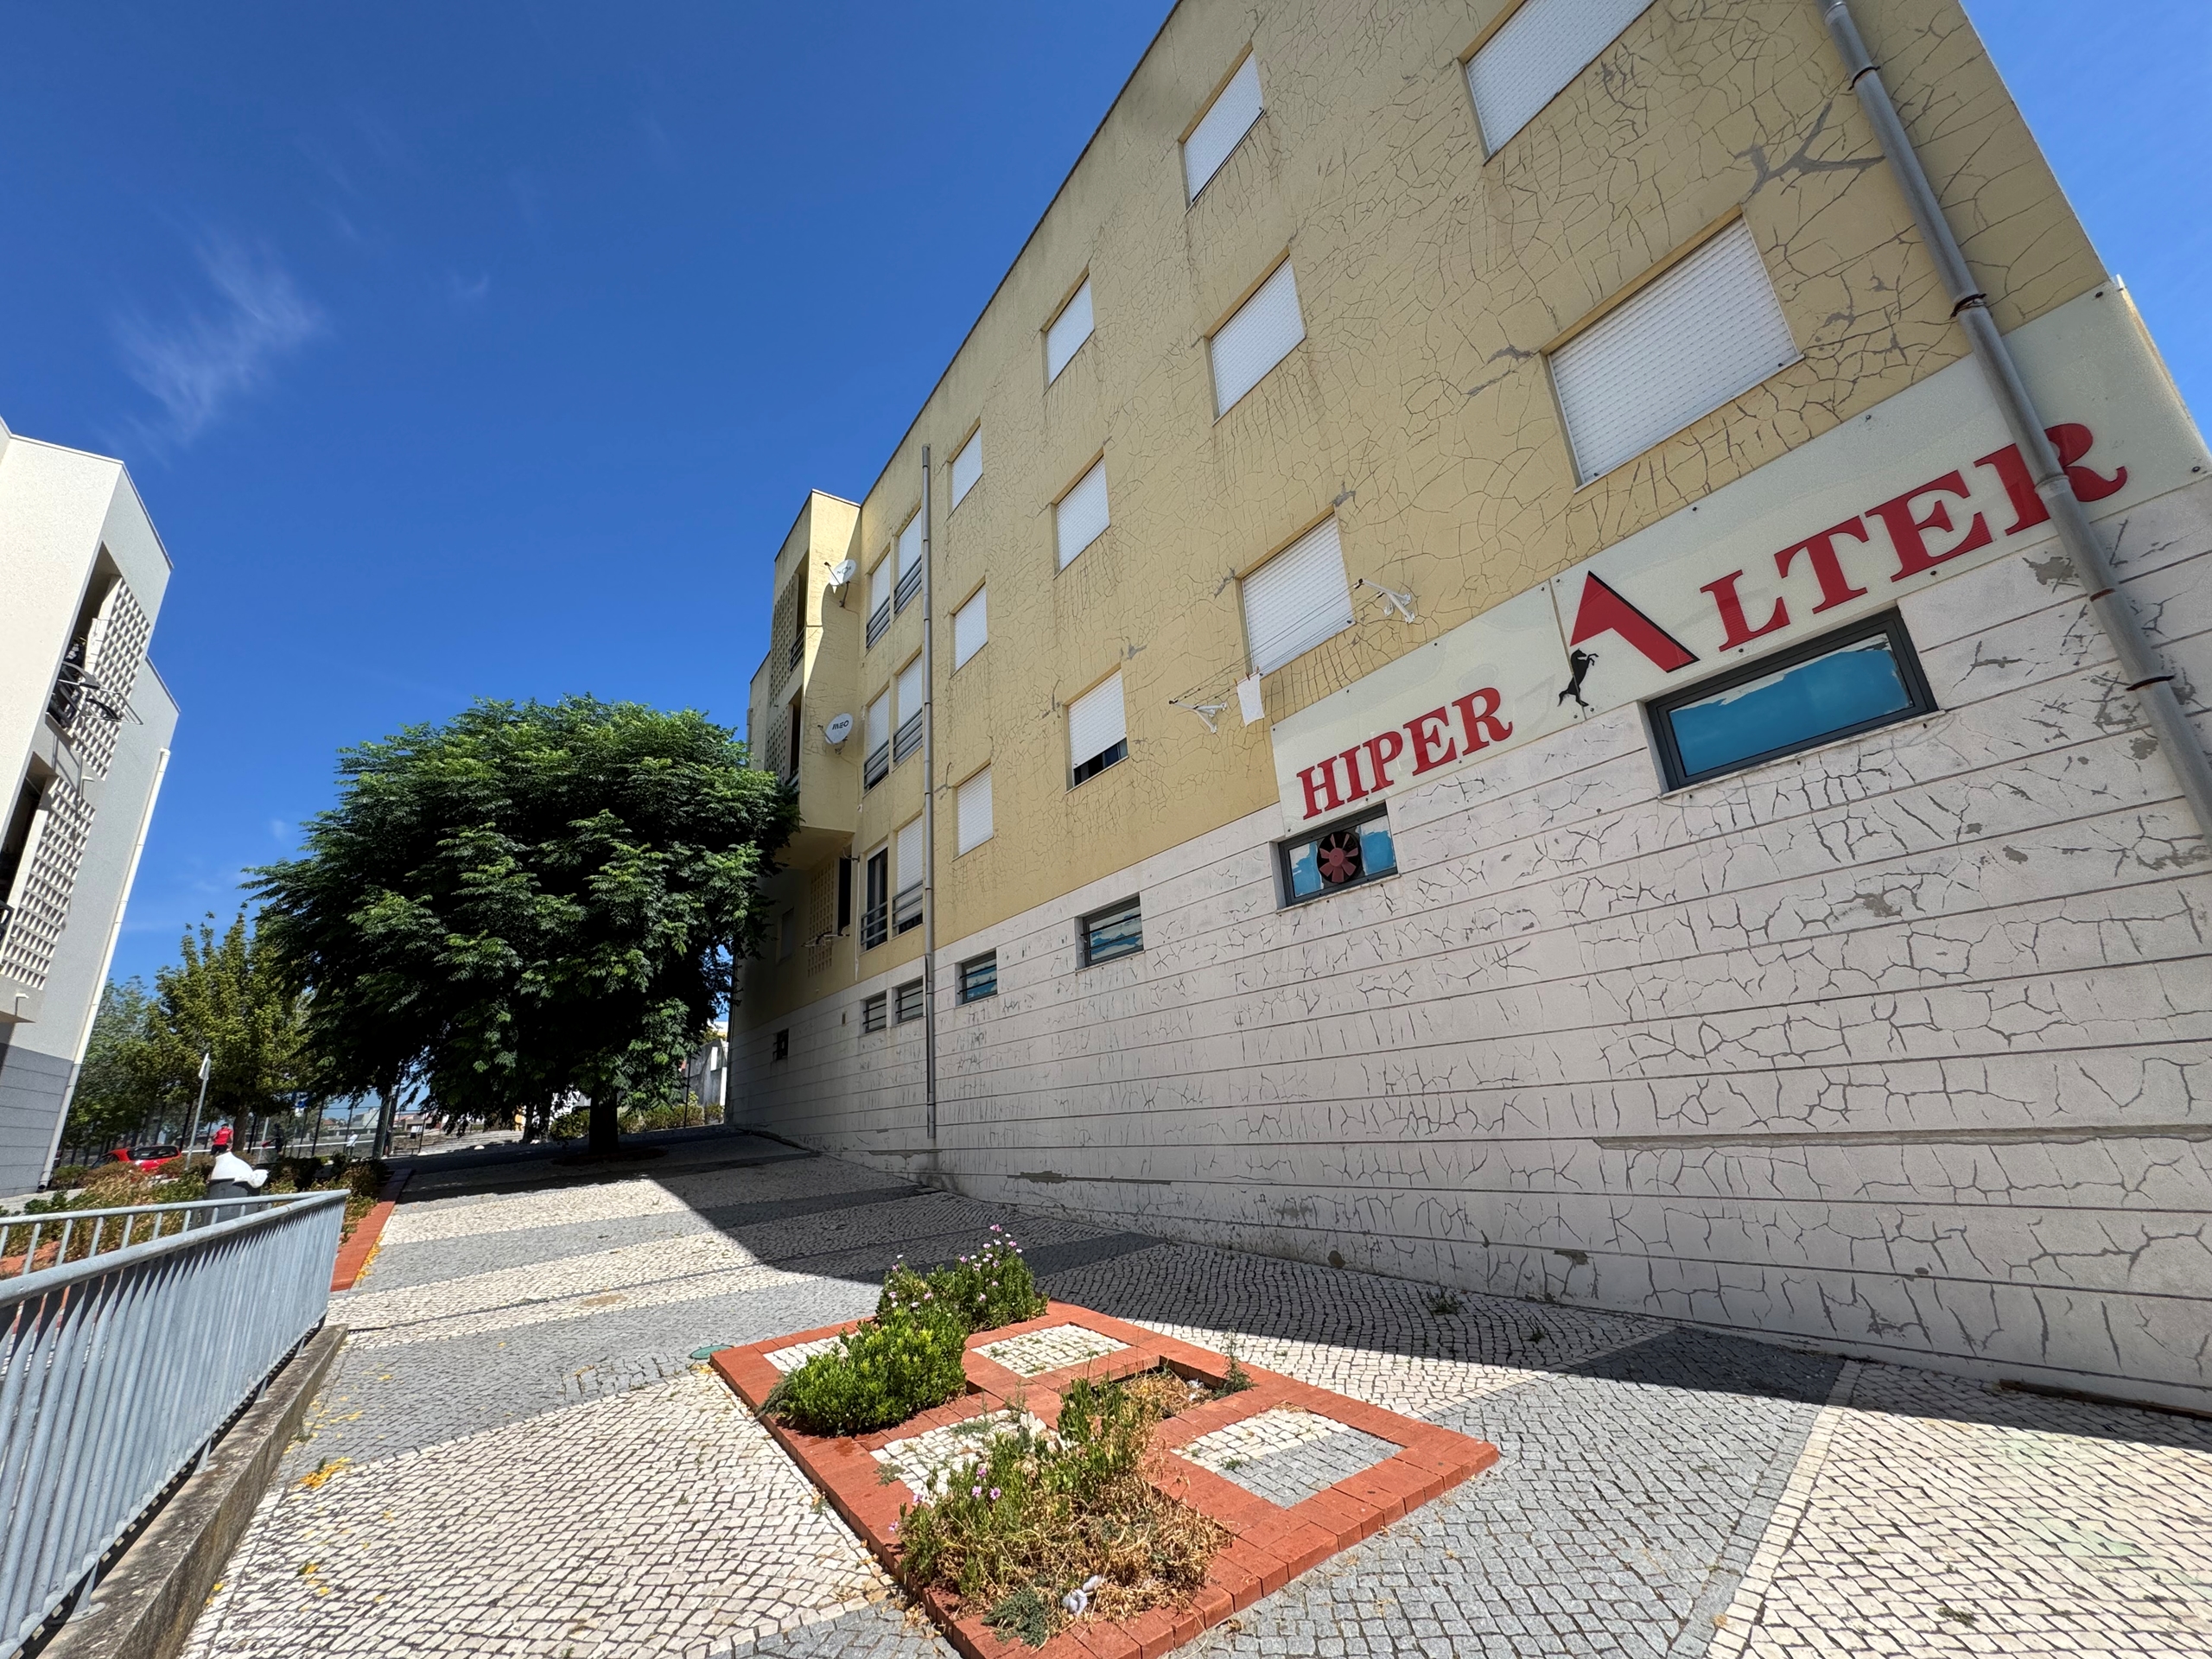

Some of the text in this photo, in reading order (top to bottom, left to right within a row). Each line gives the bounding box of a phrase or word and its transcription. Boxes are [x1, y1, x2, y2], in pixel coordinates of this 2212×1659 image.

[1296, 423, 2127, 820] HIPER ALTER
[831, 720, 849, 730] MEO
